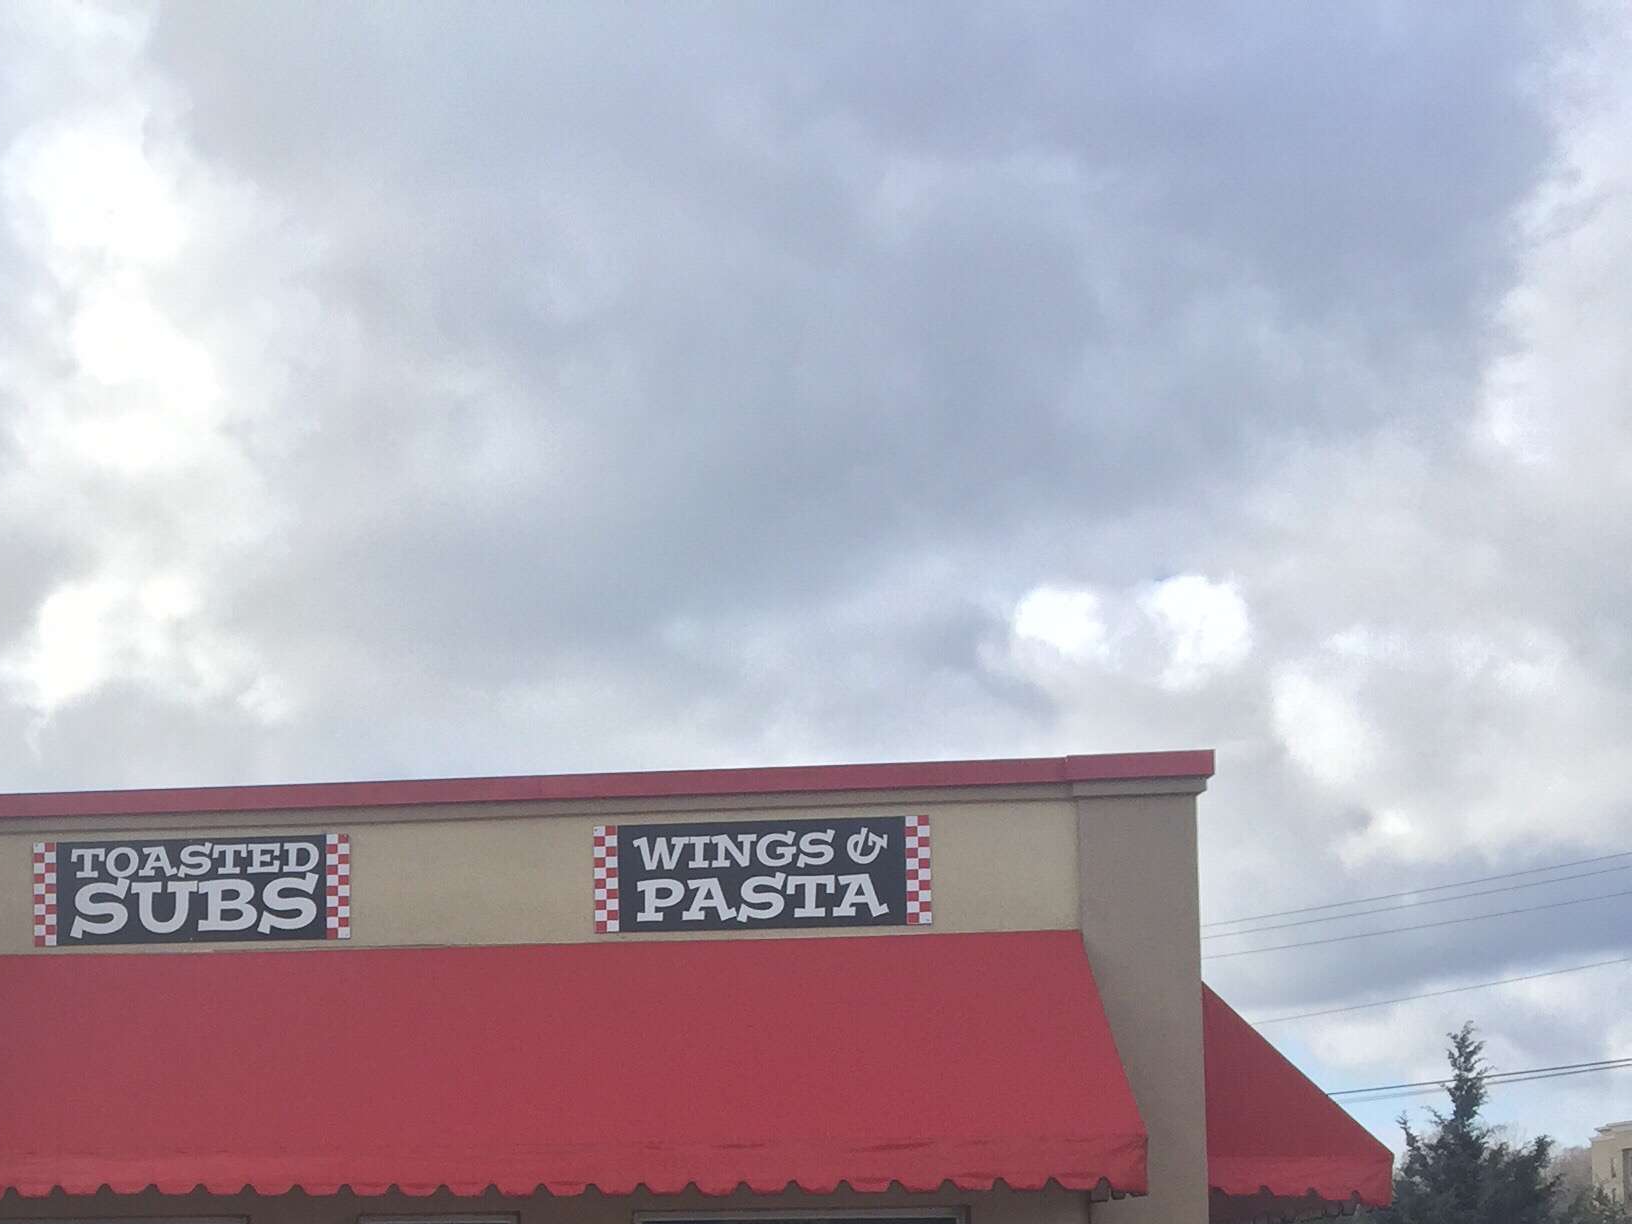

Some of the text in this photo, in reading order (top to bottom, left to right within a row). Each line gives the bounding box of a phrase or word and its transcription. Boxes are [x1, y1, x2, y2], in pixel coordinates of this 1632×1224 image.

[70, 842, 320, 878] TOASTED
[632, 827, 888, 871] WINGS &
[70, 872, 319, 939] SUBS
[636, 872, 889, 923] PASTA
